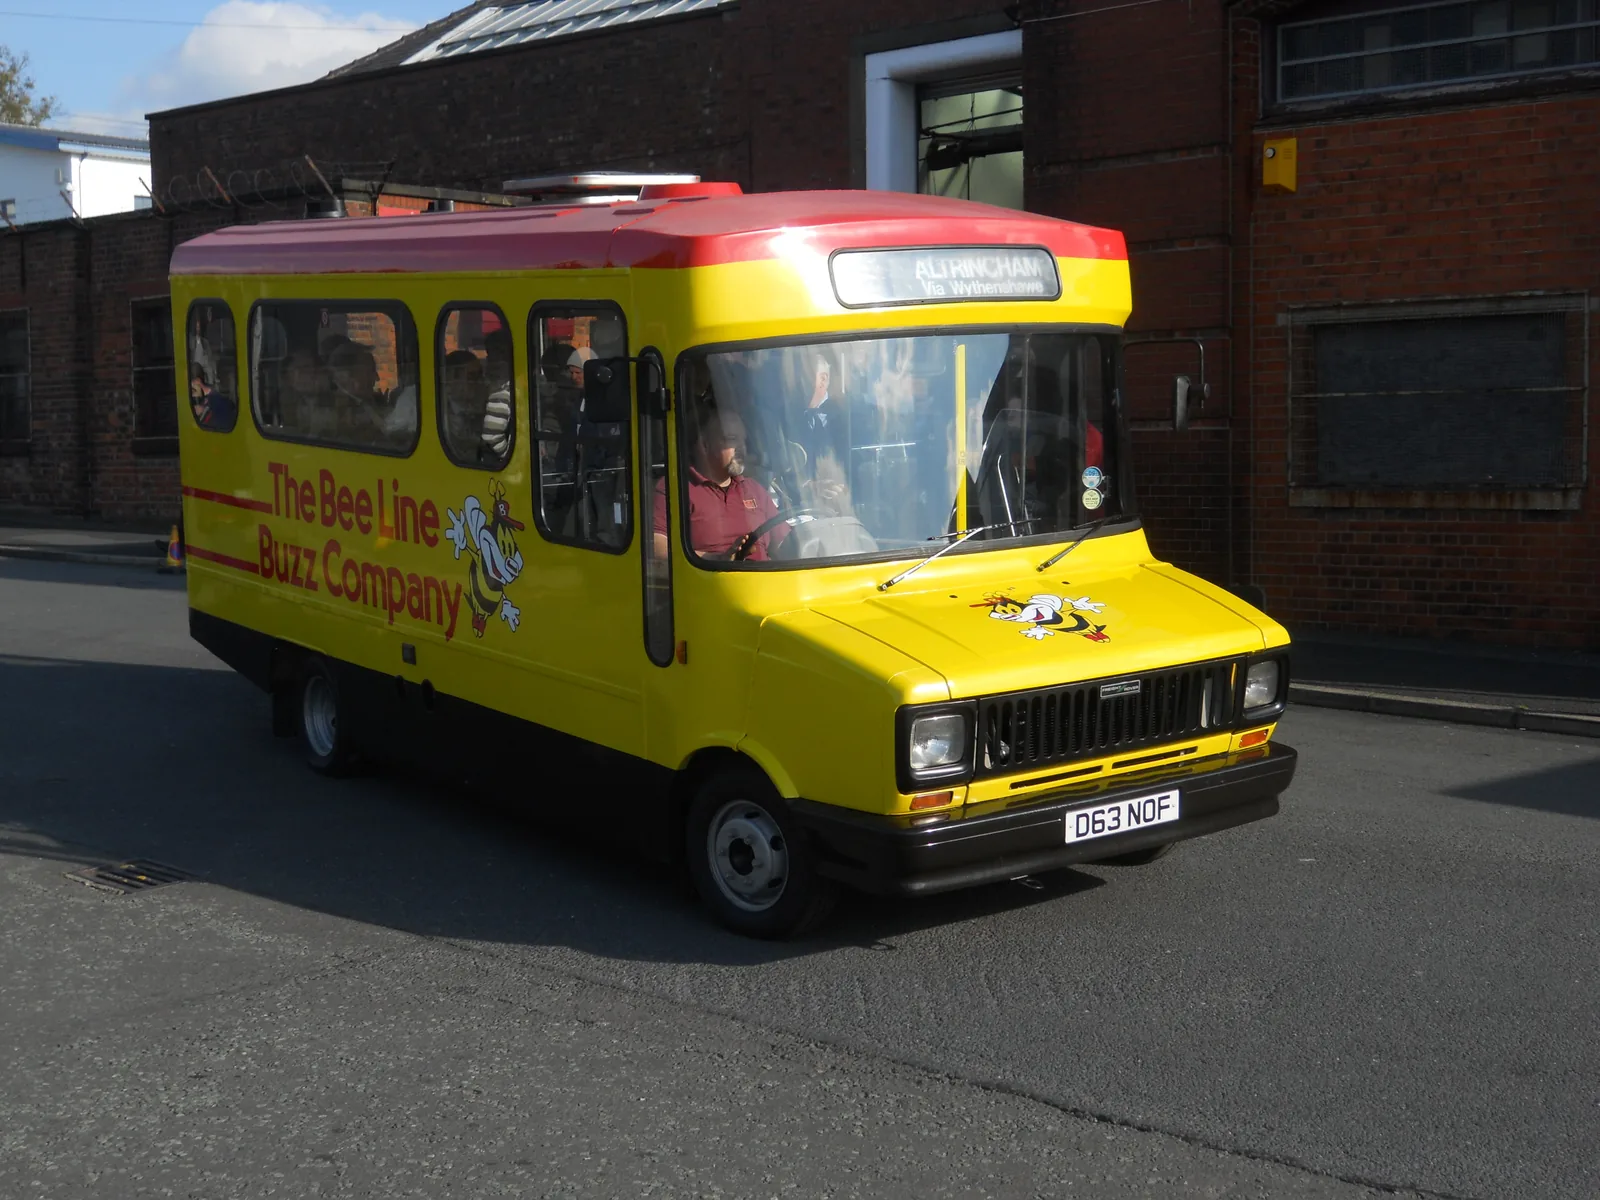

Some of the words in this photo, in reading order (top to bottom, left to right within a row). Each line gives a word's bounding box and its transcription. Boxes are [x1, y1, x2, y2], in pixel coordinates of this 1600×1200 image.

[916, 256, 1041, 279] ALTRINCHAM
[922, 280, 945, 296] Via
[951, 279, 1043, 296] Wythenshawe
[268, 461, 316, 523] The
[319, 468, 373, 535] Bee
[377, 478, 440, 548] Line
[258, 523, 319, 592] Buzz
[322, 538, 462, 642] Company
[1075, 805, 1121, 839] D63
[1127, 794, 1171, 827] NOF
